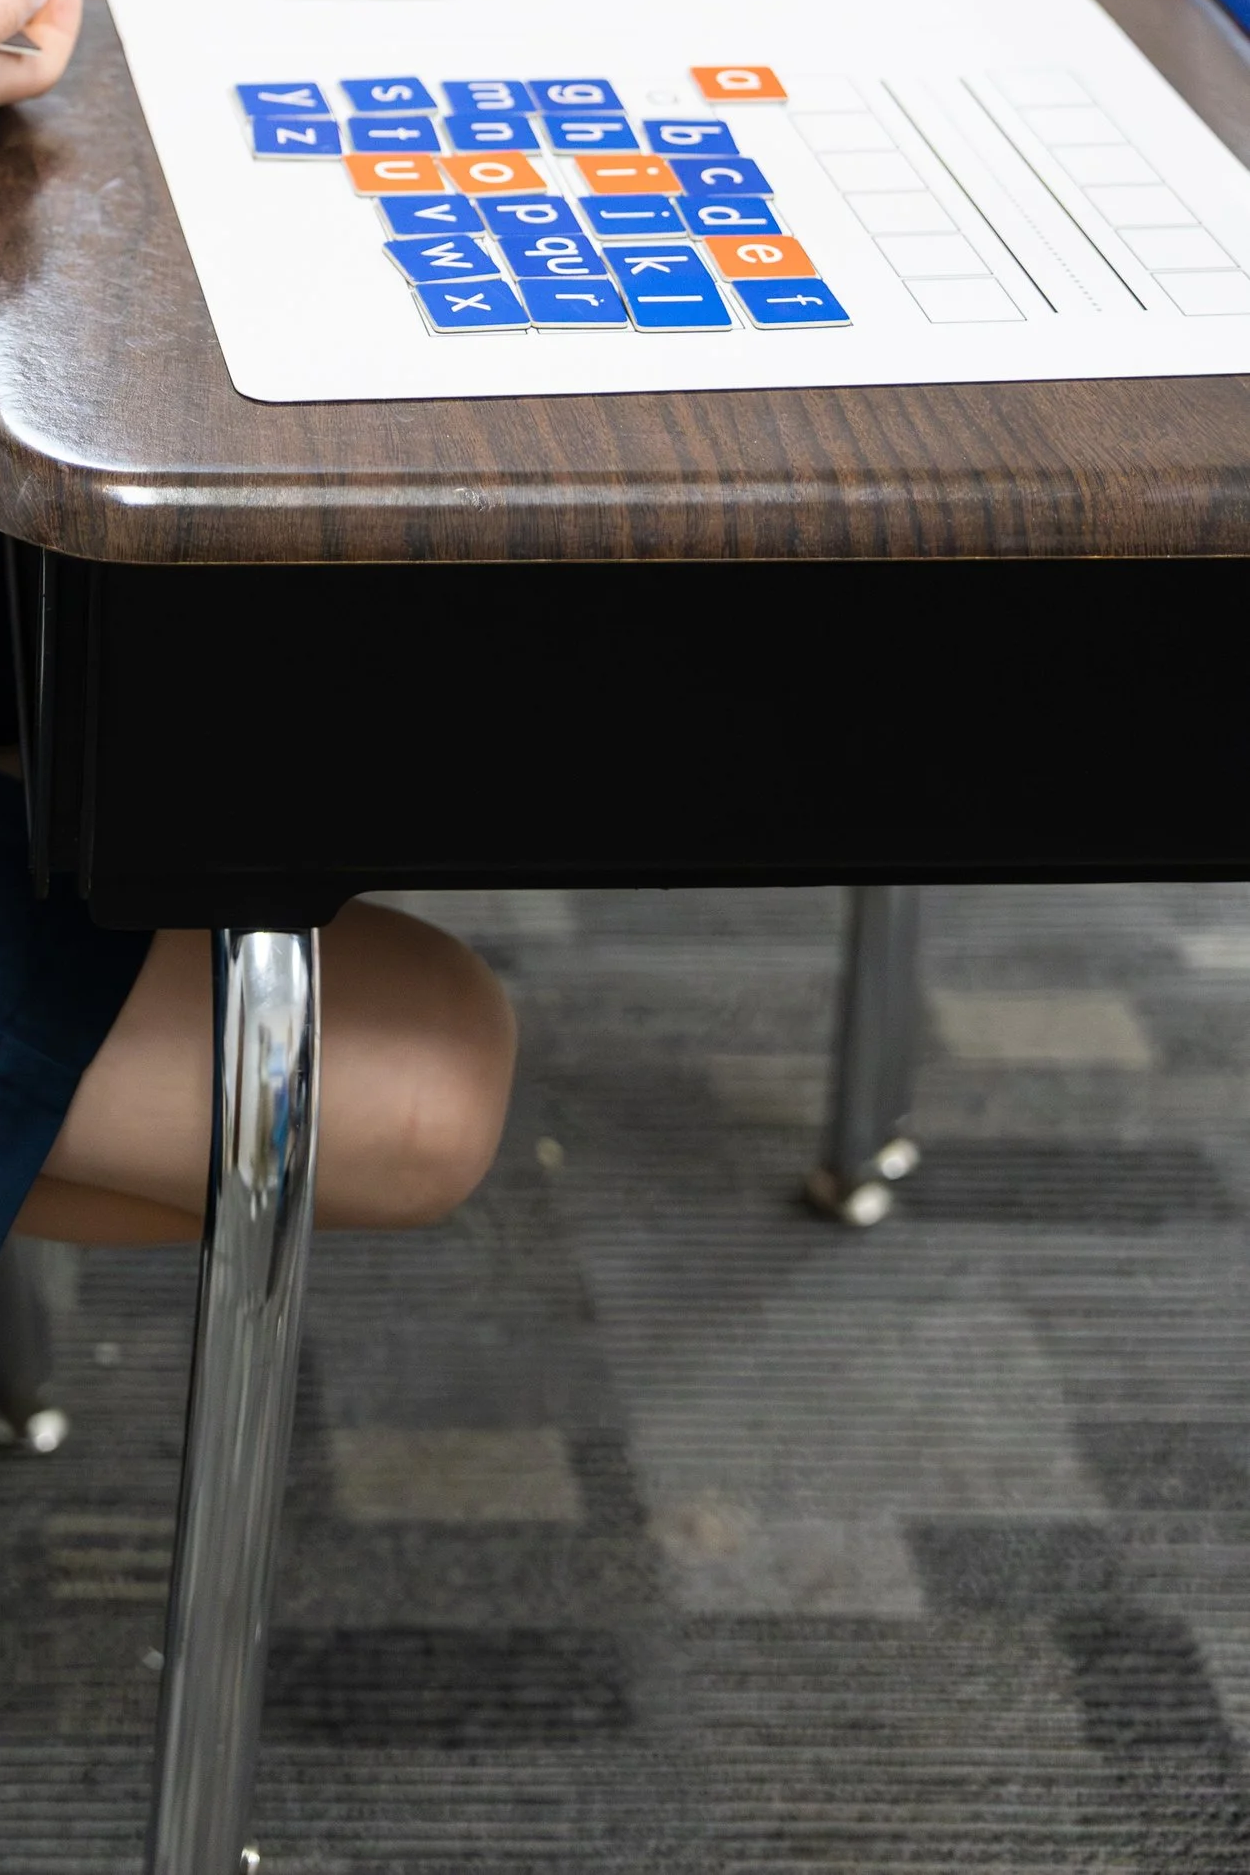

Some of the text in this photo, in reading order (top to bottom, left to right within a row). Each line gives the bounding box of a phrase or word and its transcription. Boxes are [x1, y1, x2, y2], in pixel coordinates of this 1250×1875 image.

[716, 69, 761, 90] a
[547, 84, 604, 104] g
[258, 88, 317, 145] y z
[561, 122, 623, 142] h
[659, 125, 721, 146] b
[596, 167, 659, 177] i
[700, 167, 743, 185] c
[368, 85, 492, 313] s t u v w x
[468, 82, 599, 307] m n o p qu r
[599, 210, 670, 219] j
[697, 205, 767, 226] d
[736, 243, 783, 264] e
[624, 255, 689, 275] k
[766, 294, 824, 306] f
